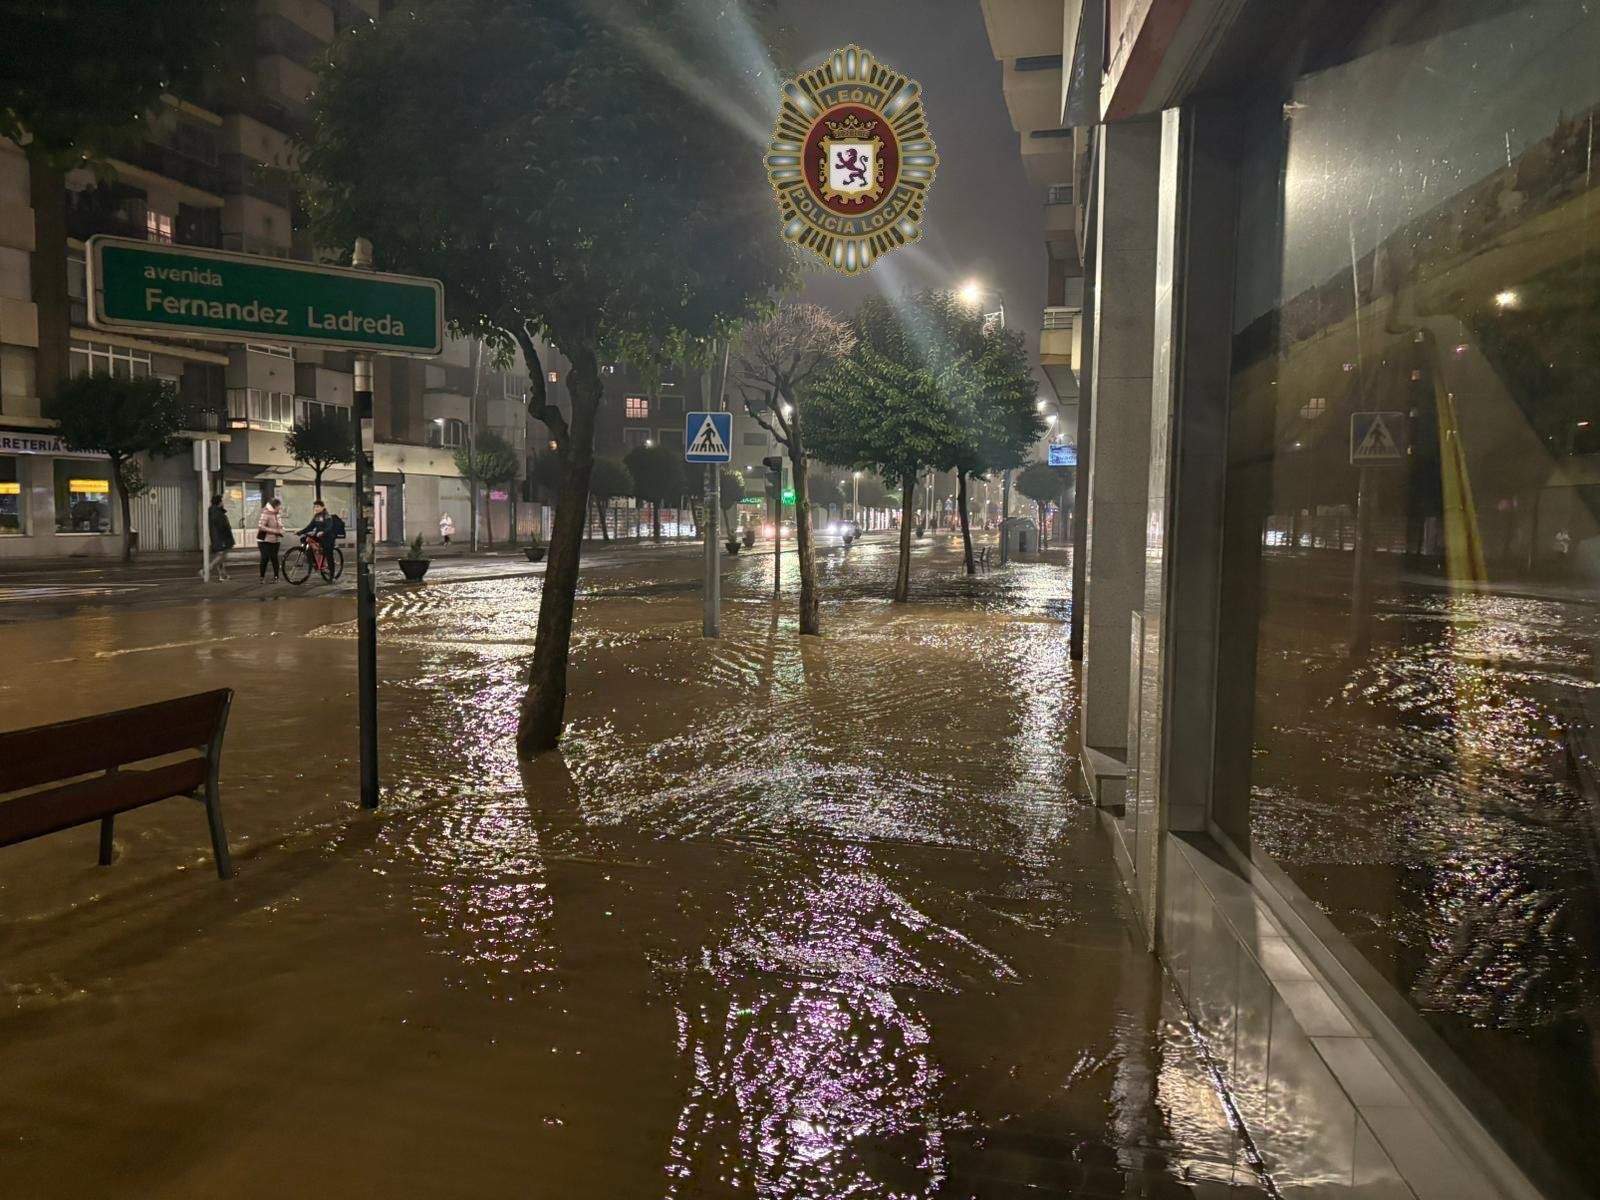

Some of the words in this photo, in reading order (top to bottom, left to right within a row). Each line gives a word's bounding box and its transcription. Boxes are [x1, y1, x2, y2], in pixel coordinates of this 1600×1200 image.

[143, 263, 223, 287] avenida
[145, 287, 288, 326] Fernandez
[307, 305, 405, 337] Ladreda
